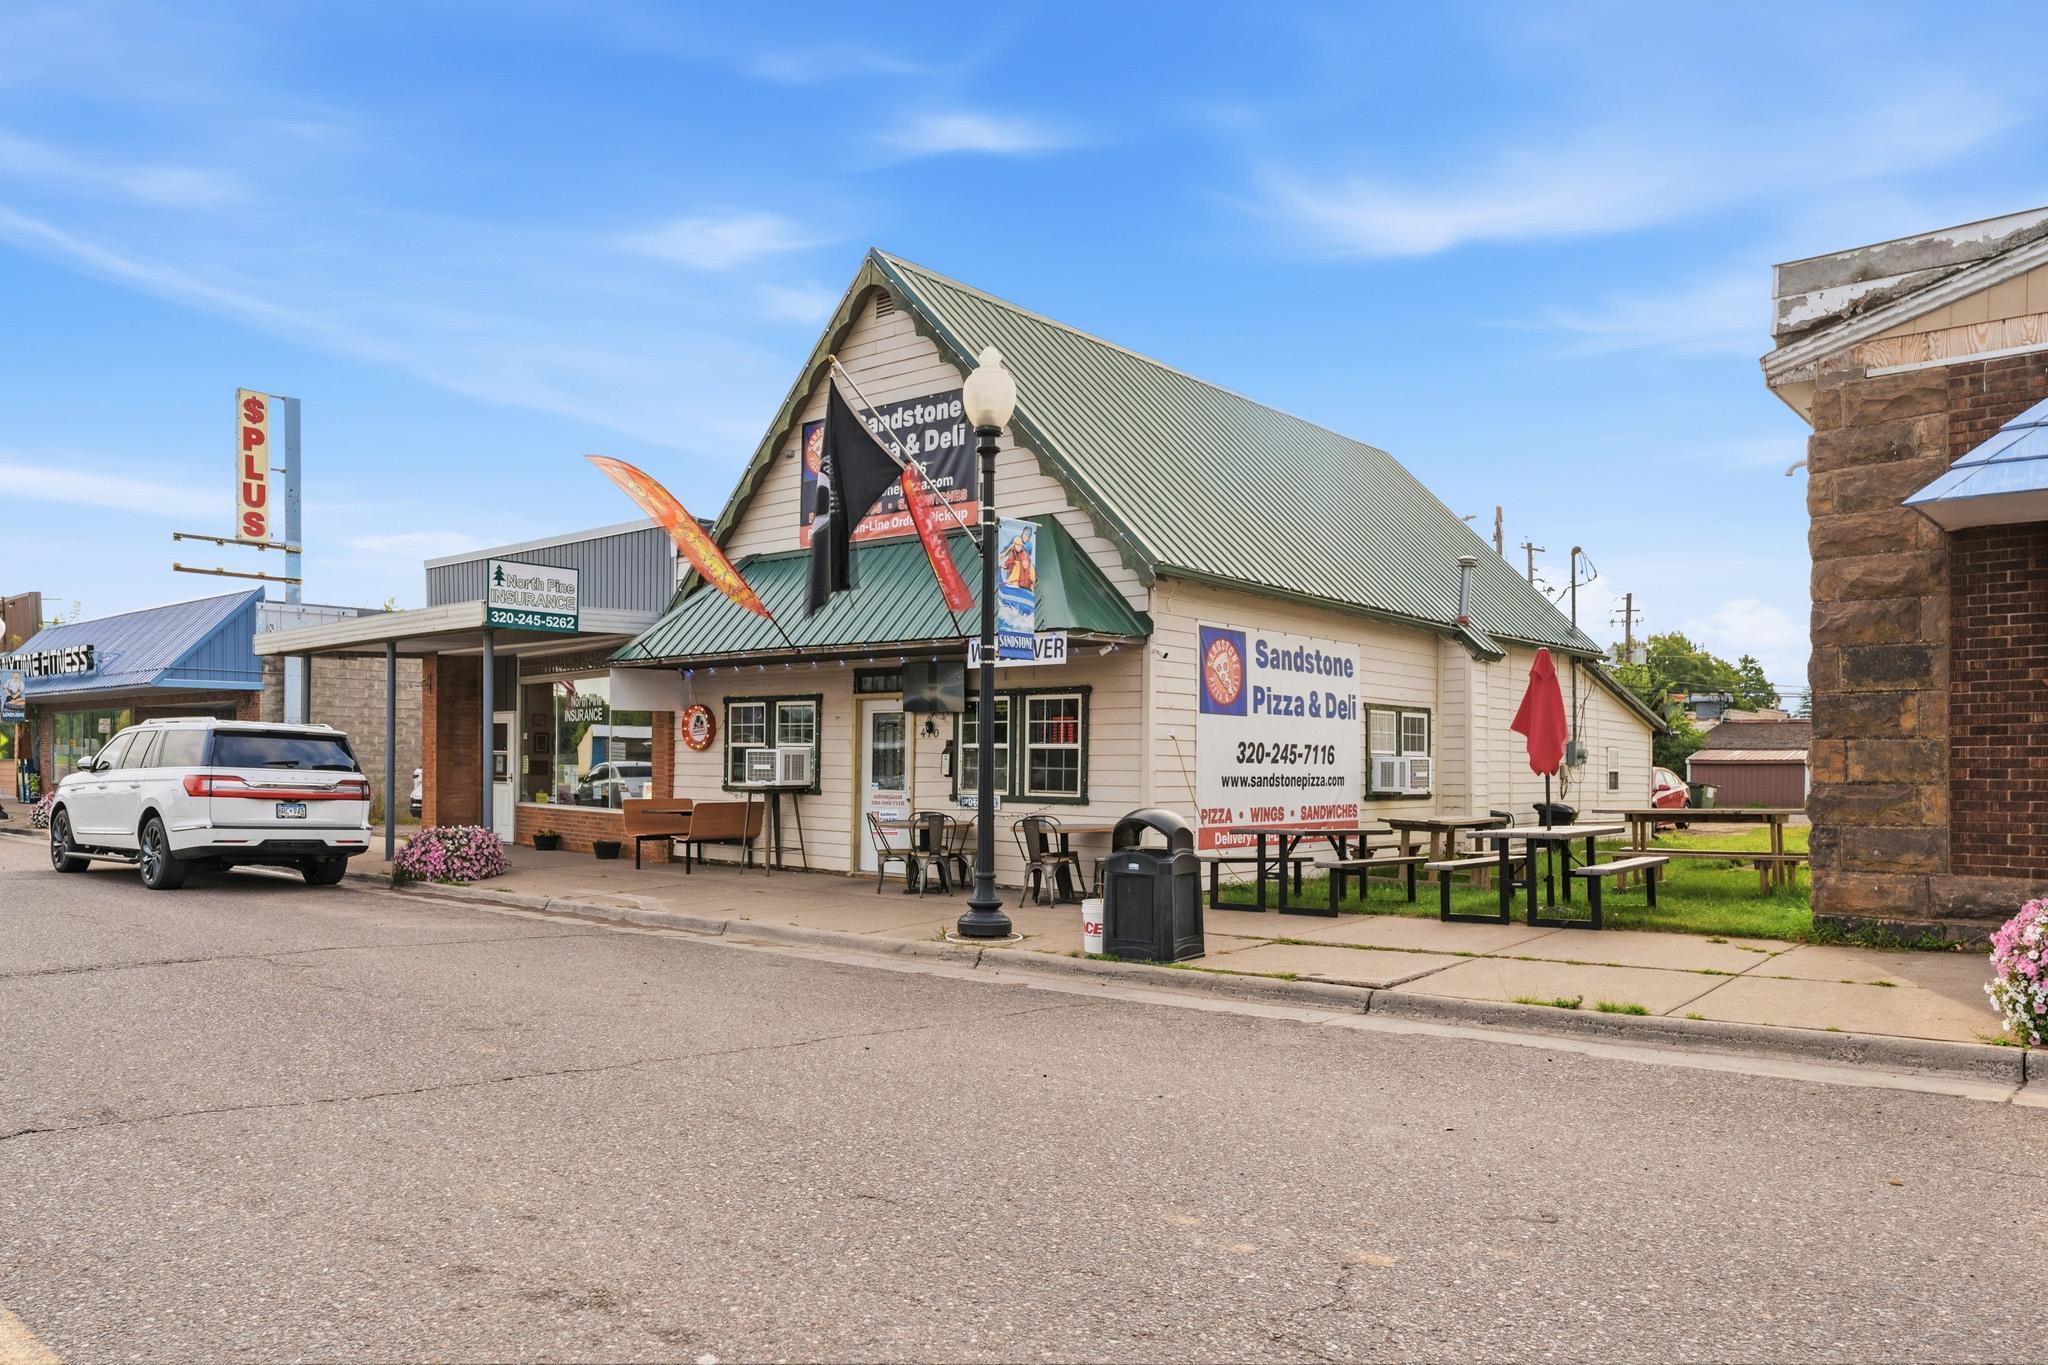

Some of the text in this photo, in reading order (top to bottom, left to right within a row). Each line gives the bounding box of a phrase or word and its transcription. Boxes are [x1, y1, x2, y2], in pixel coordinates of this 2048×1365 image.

[905, 432, 920, 455] &
[925, 423, 965, 452] Deli
[507, 574, 575, 594] North Pine
[491, 588, 575, 610] INSURANCE
[491, 611, 575, 628] 320-245-5262
[999, 634, 1033, 650] SANDSTONE
[41, 645, 90, 676] FITNESS
[1255, 639, 1354, 678] Sandstone
[1253, 685, 1305, 717] Pizza
[1309, 690, 1321, 718] &
[1326, 692, 1356, 720] Deli
[565, 707, 603, 722] INSURANCE
[1236, 741, 1335, 765] 320-245-7116
[1221, 773, 1345, 790] www.sandstonepizza.com
[1201, 803, 1358, 824] PIZZA WINGS SANDWICHES
[1215, 832, 1252, 847] Delivery
